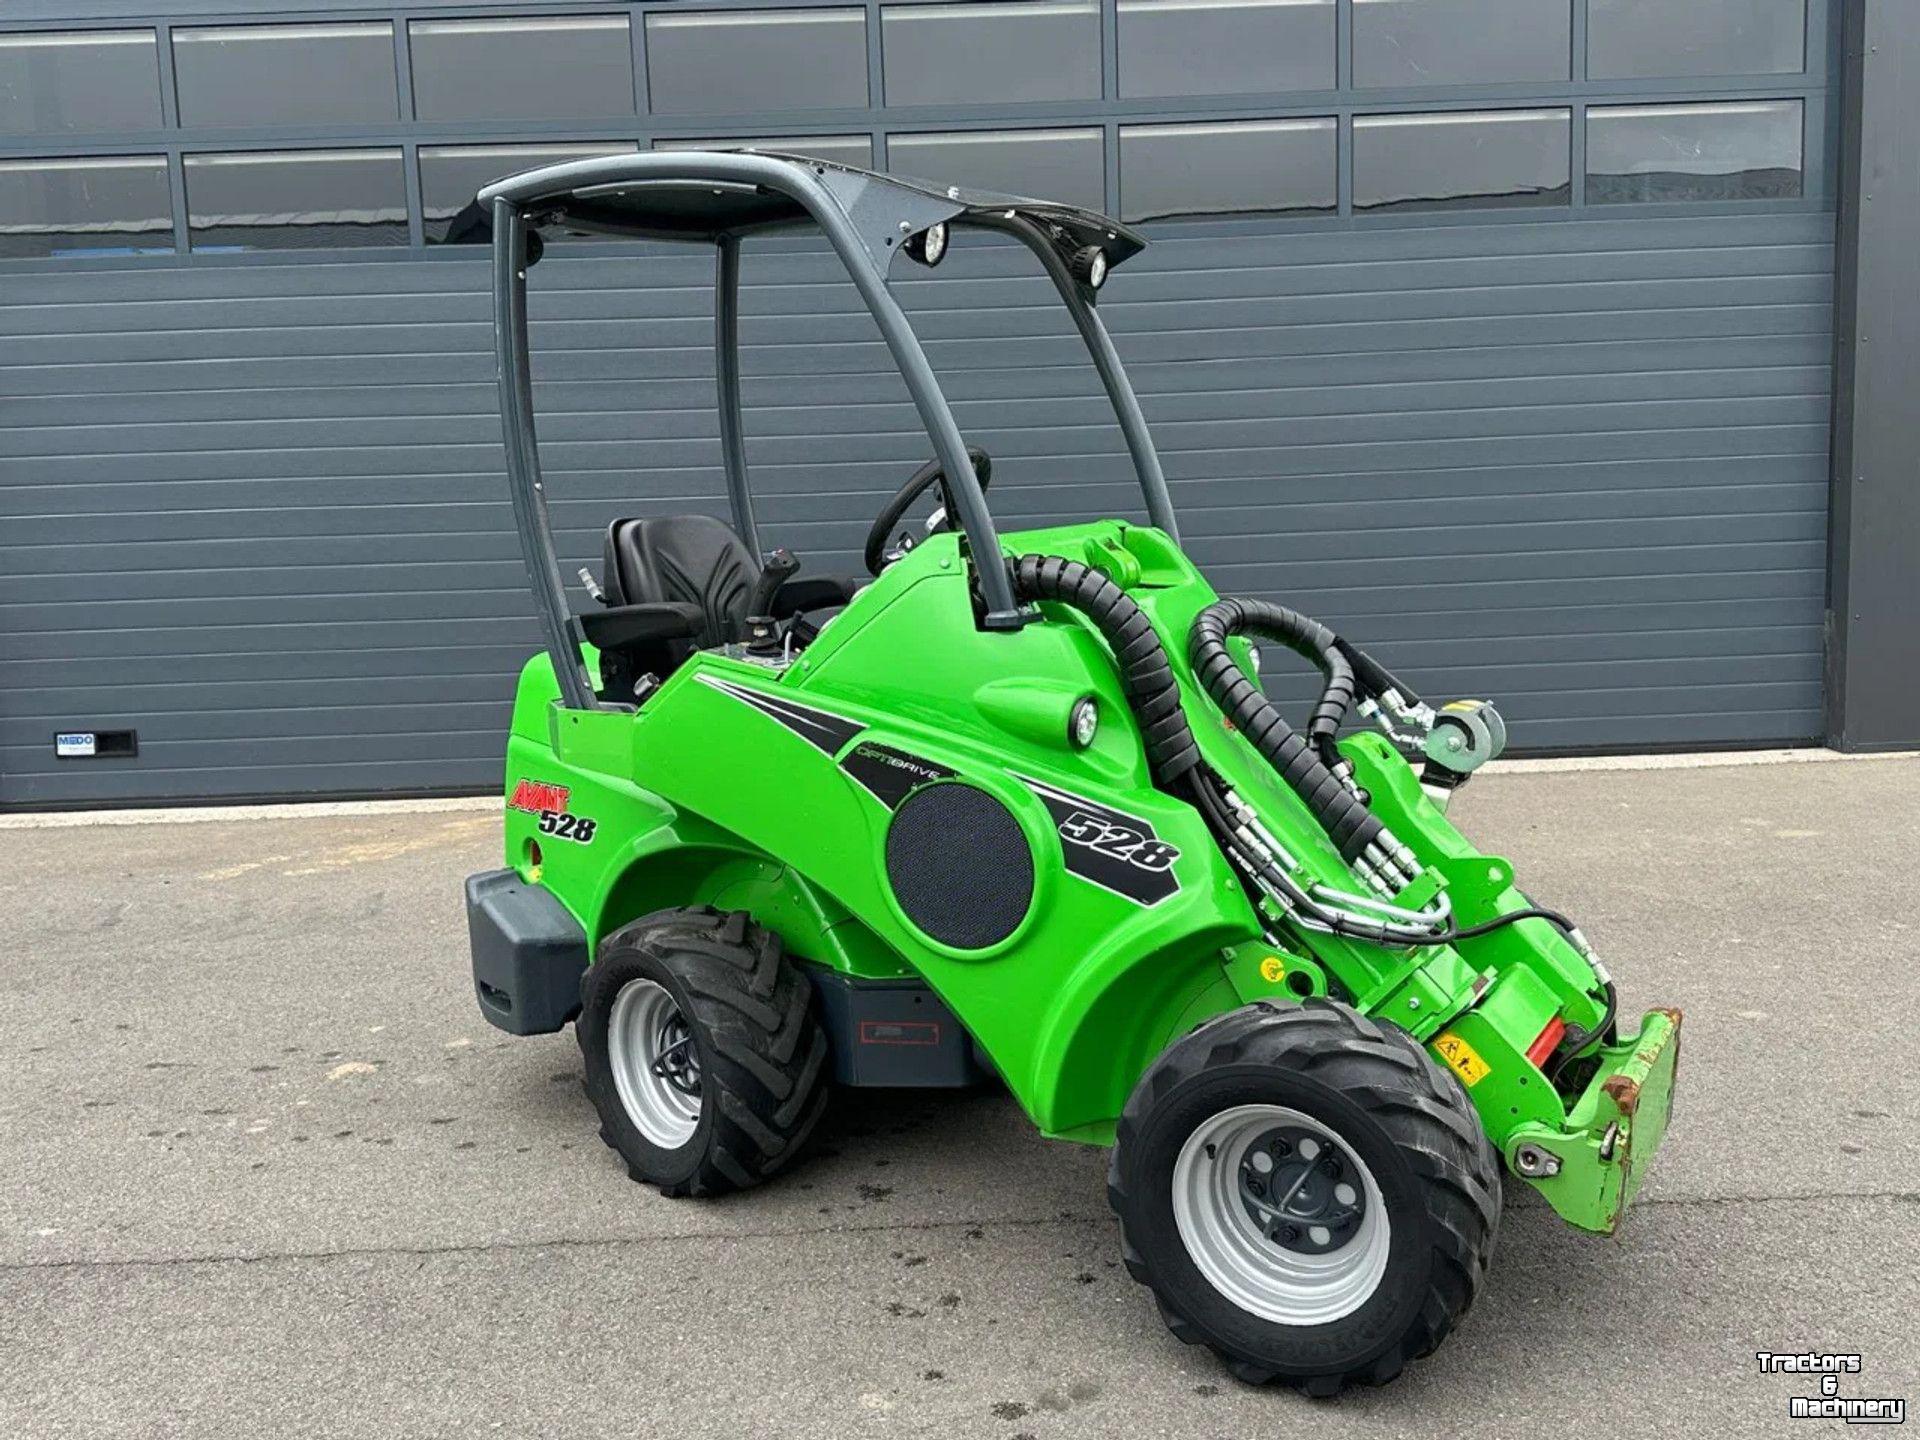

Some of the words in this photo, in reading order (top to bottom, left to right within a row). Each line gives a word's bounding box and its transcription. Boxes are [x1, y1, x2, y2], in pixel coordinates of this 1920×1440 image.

[507, 778, 571, 814] AVANT
[539, 809, 597, 843] 528
[1058, 812, 1181, 872] 528
